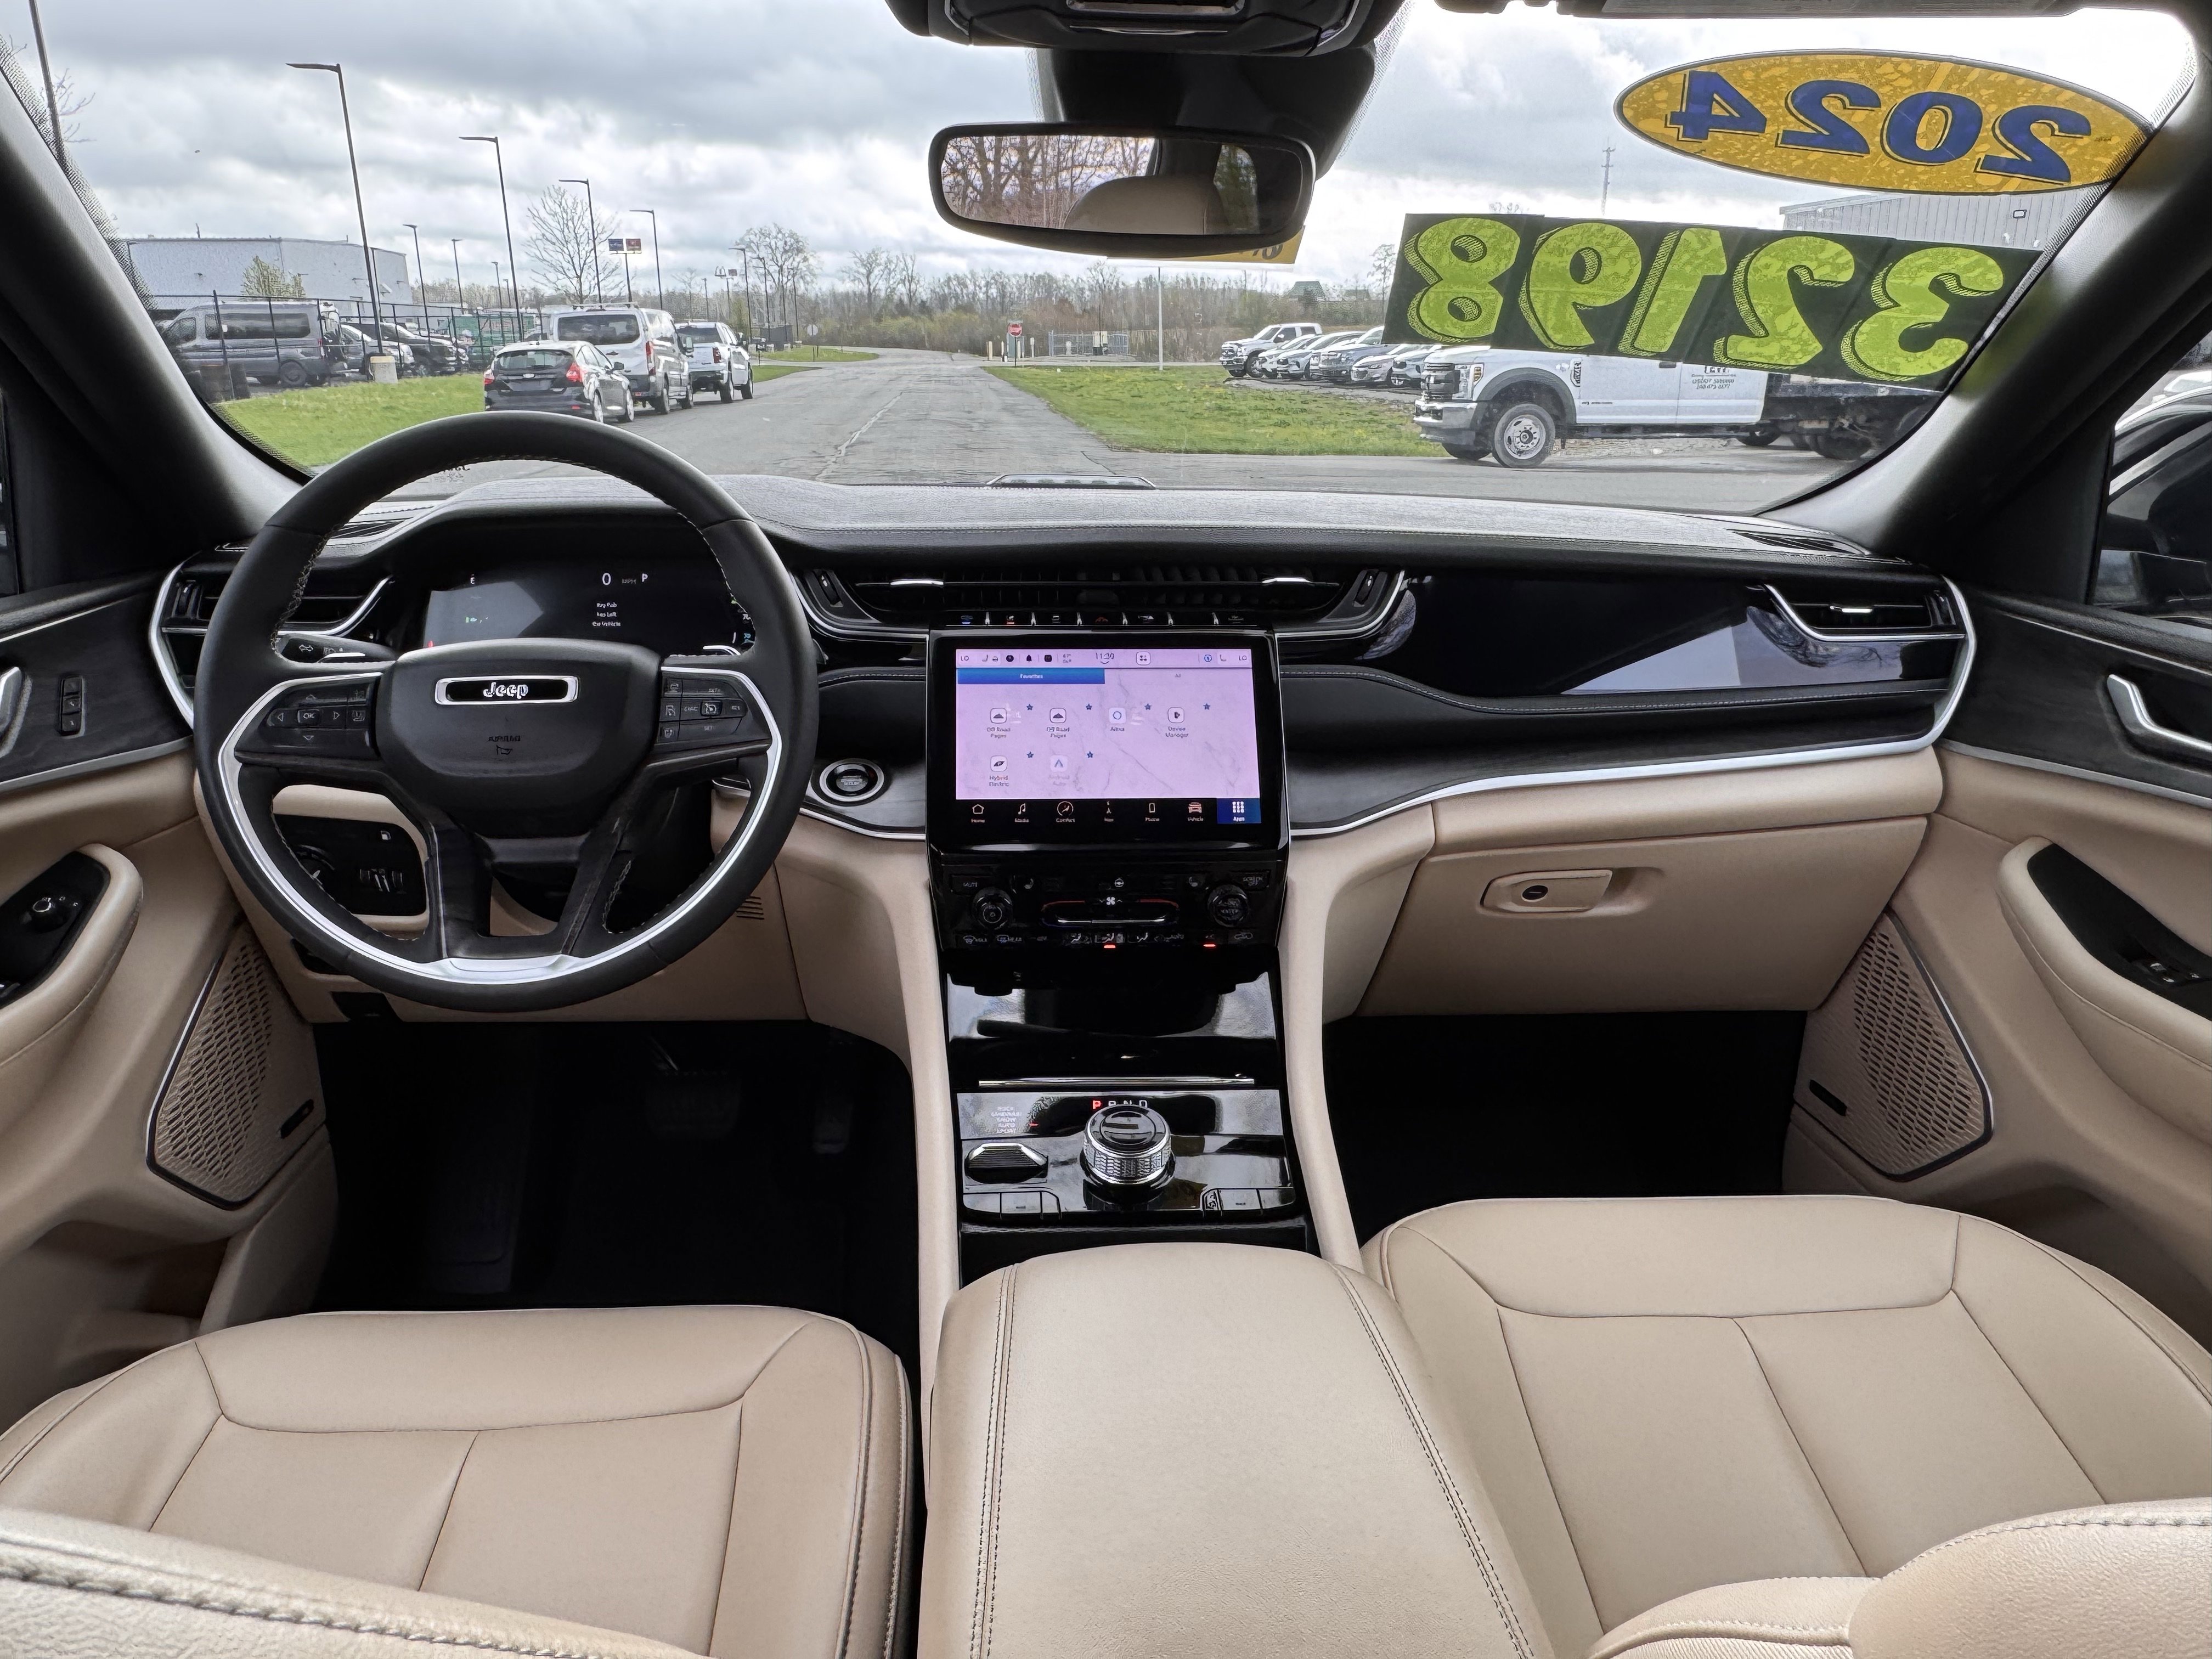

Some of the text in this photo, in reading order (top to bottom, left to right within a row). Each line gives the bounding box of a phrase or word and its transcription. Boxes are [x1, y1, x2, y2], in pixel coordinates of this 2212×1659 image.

[642, 573, 648, 582] P
[483, 682, 529, 699] Jeep
[1092, 1099, 1102, 1109] P
